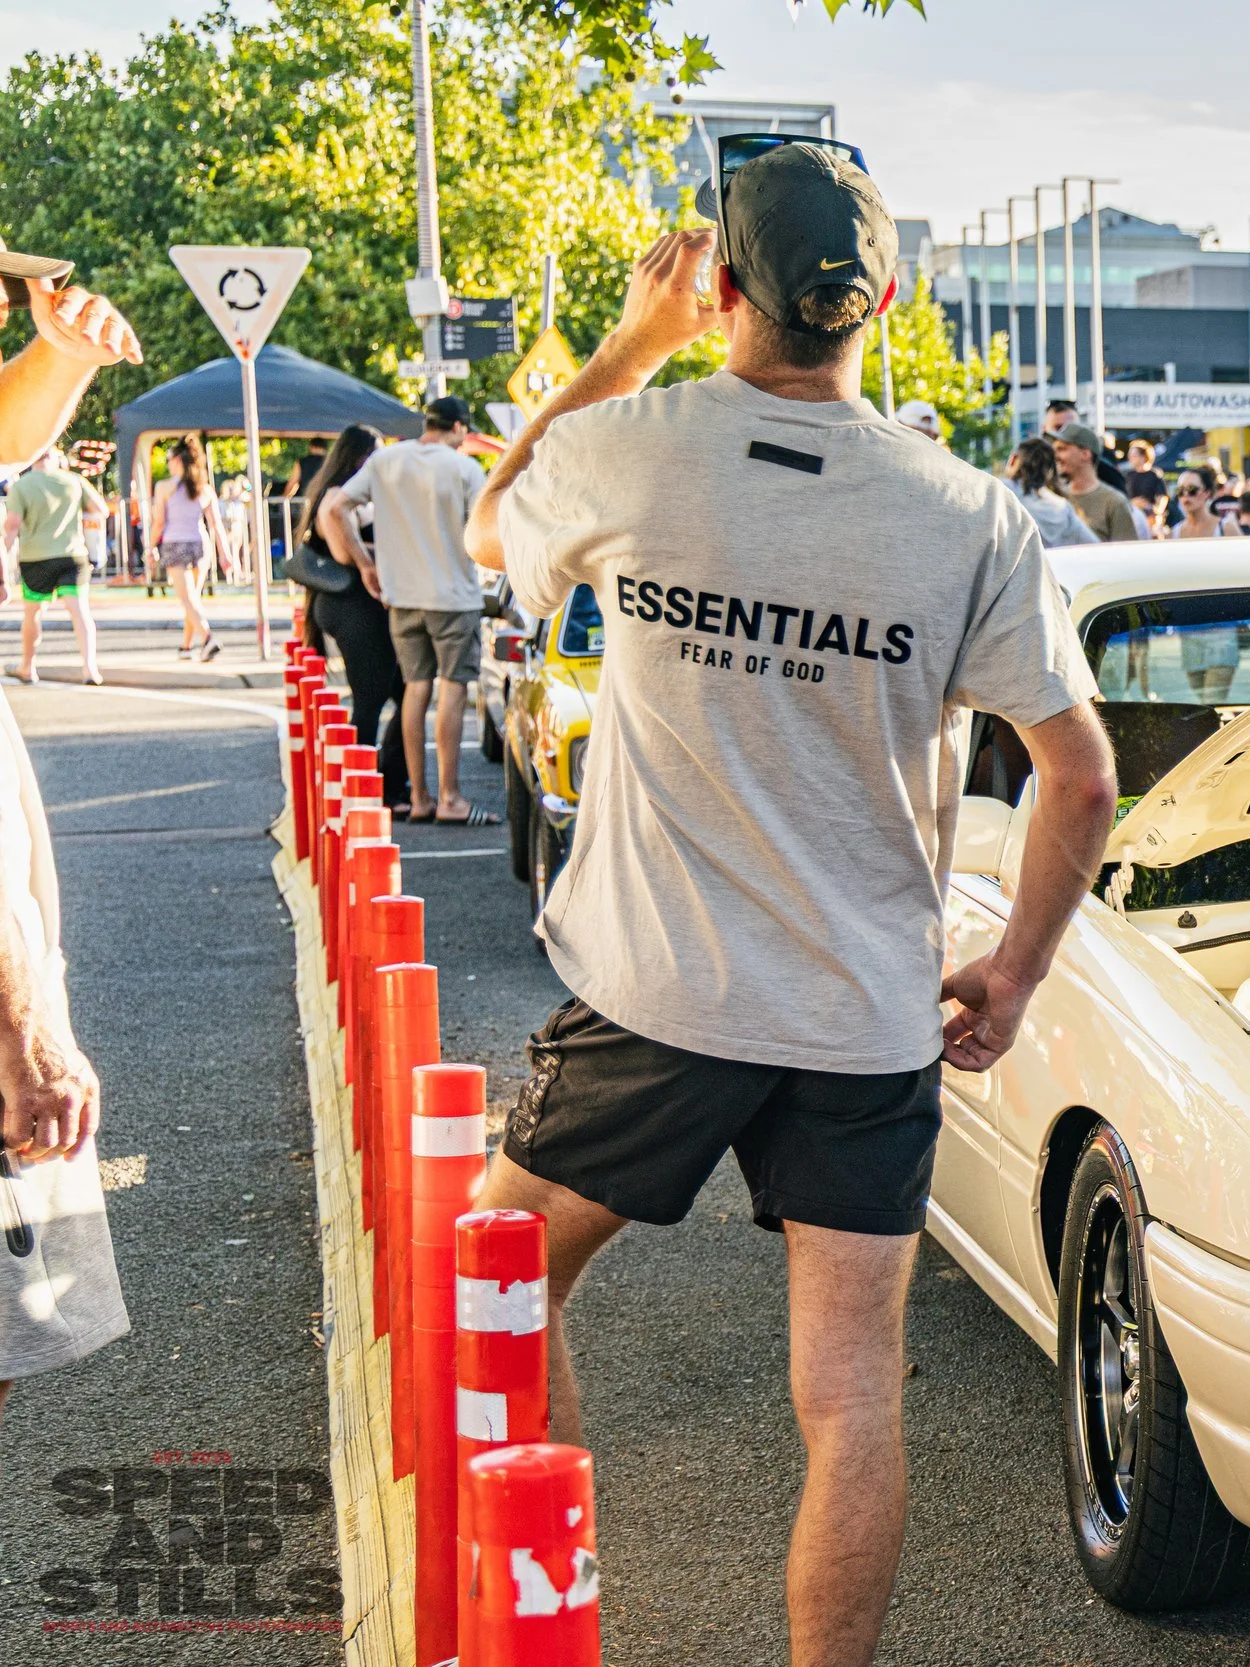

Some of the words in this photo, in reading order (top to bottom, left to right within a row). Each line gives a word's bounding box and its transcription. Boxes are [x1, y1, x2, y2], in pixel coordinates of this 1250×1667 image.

[617, 574, 914, 664] ESSENTIALS
[681, 641, 733, 670] FEAR
[745, 655, 771, 675] OF
[782, 659, 825, 683] GOD
